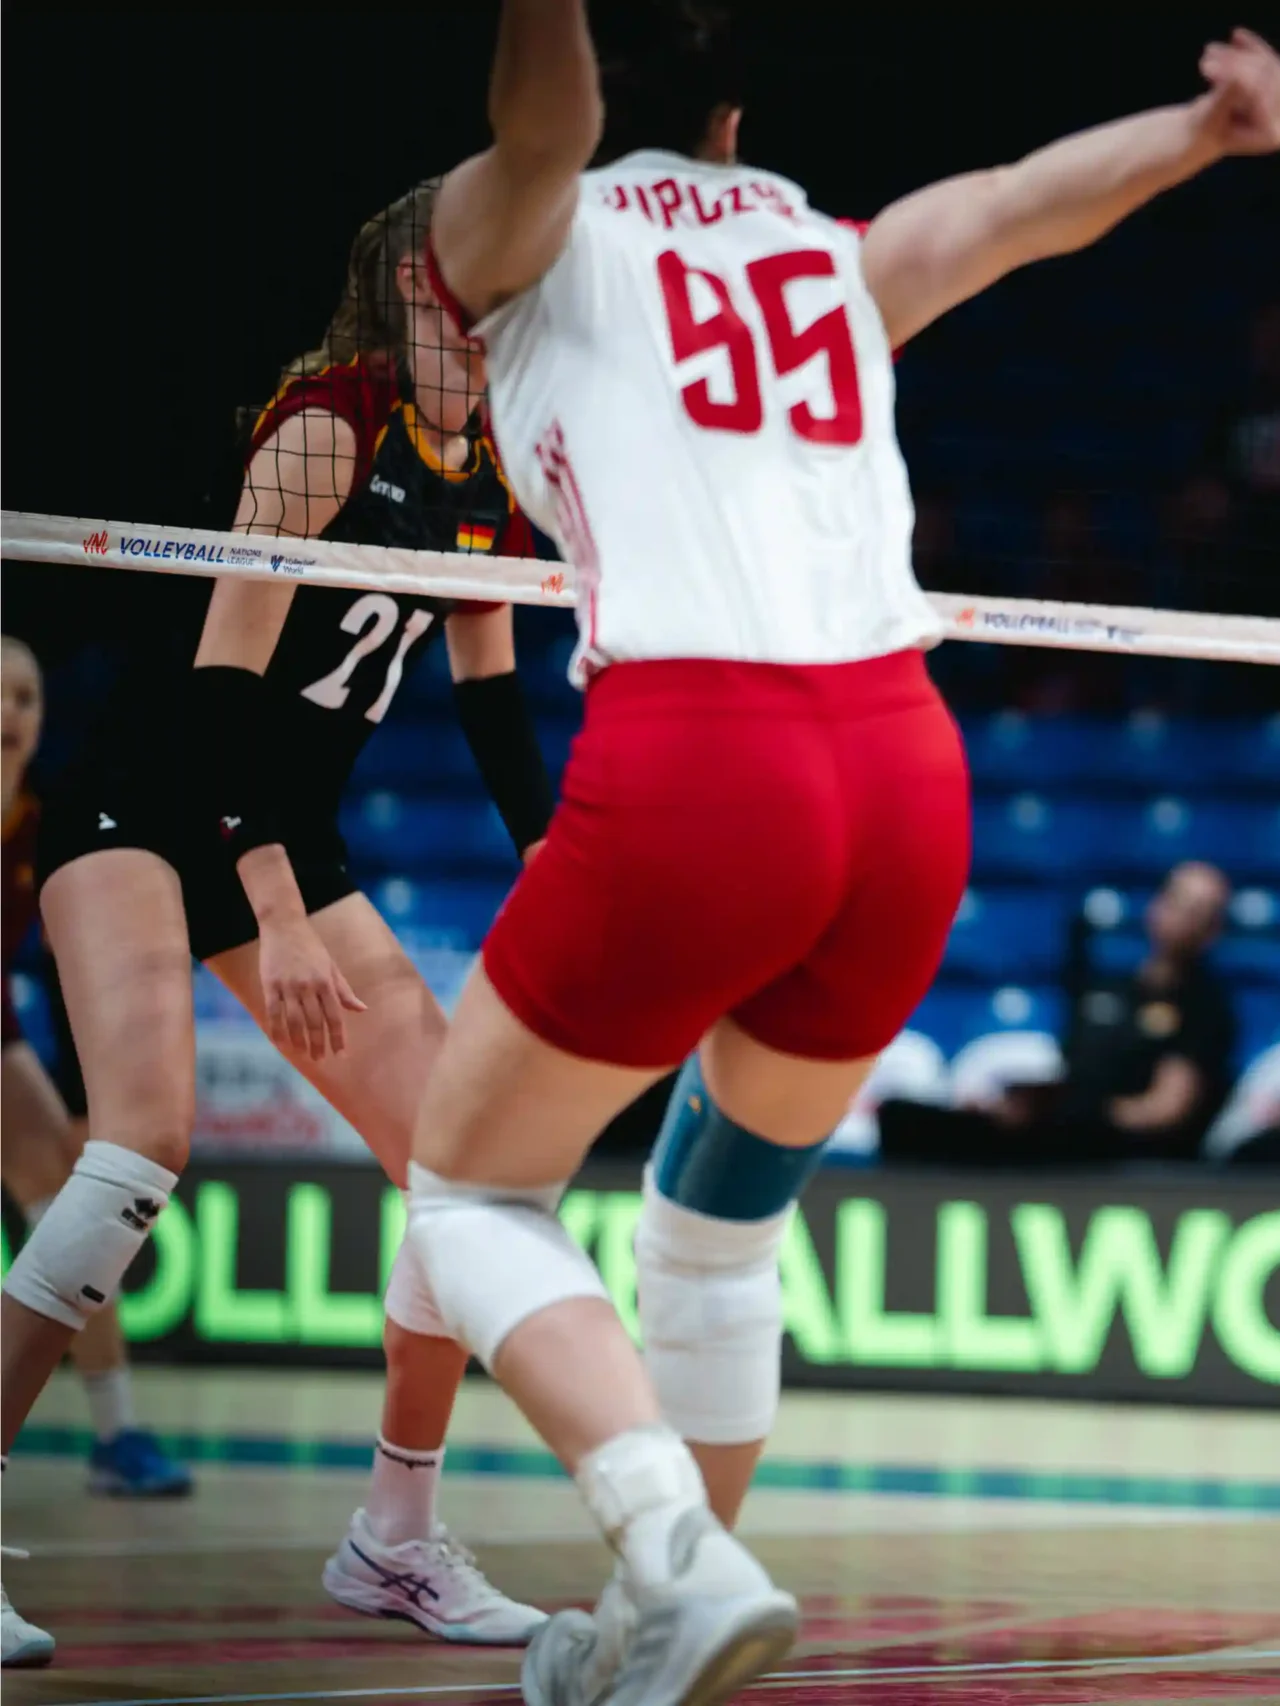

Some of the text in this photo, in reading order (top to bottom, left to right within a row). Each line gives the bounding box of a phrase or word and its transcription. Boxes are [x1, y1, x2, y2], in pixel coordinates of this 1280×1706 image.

[656, 249, 863, 447] 95
[120, 537, 224, 564] VOLLEYBALL
[300, 592, 435, 724] 21
